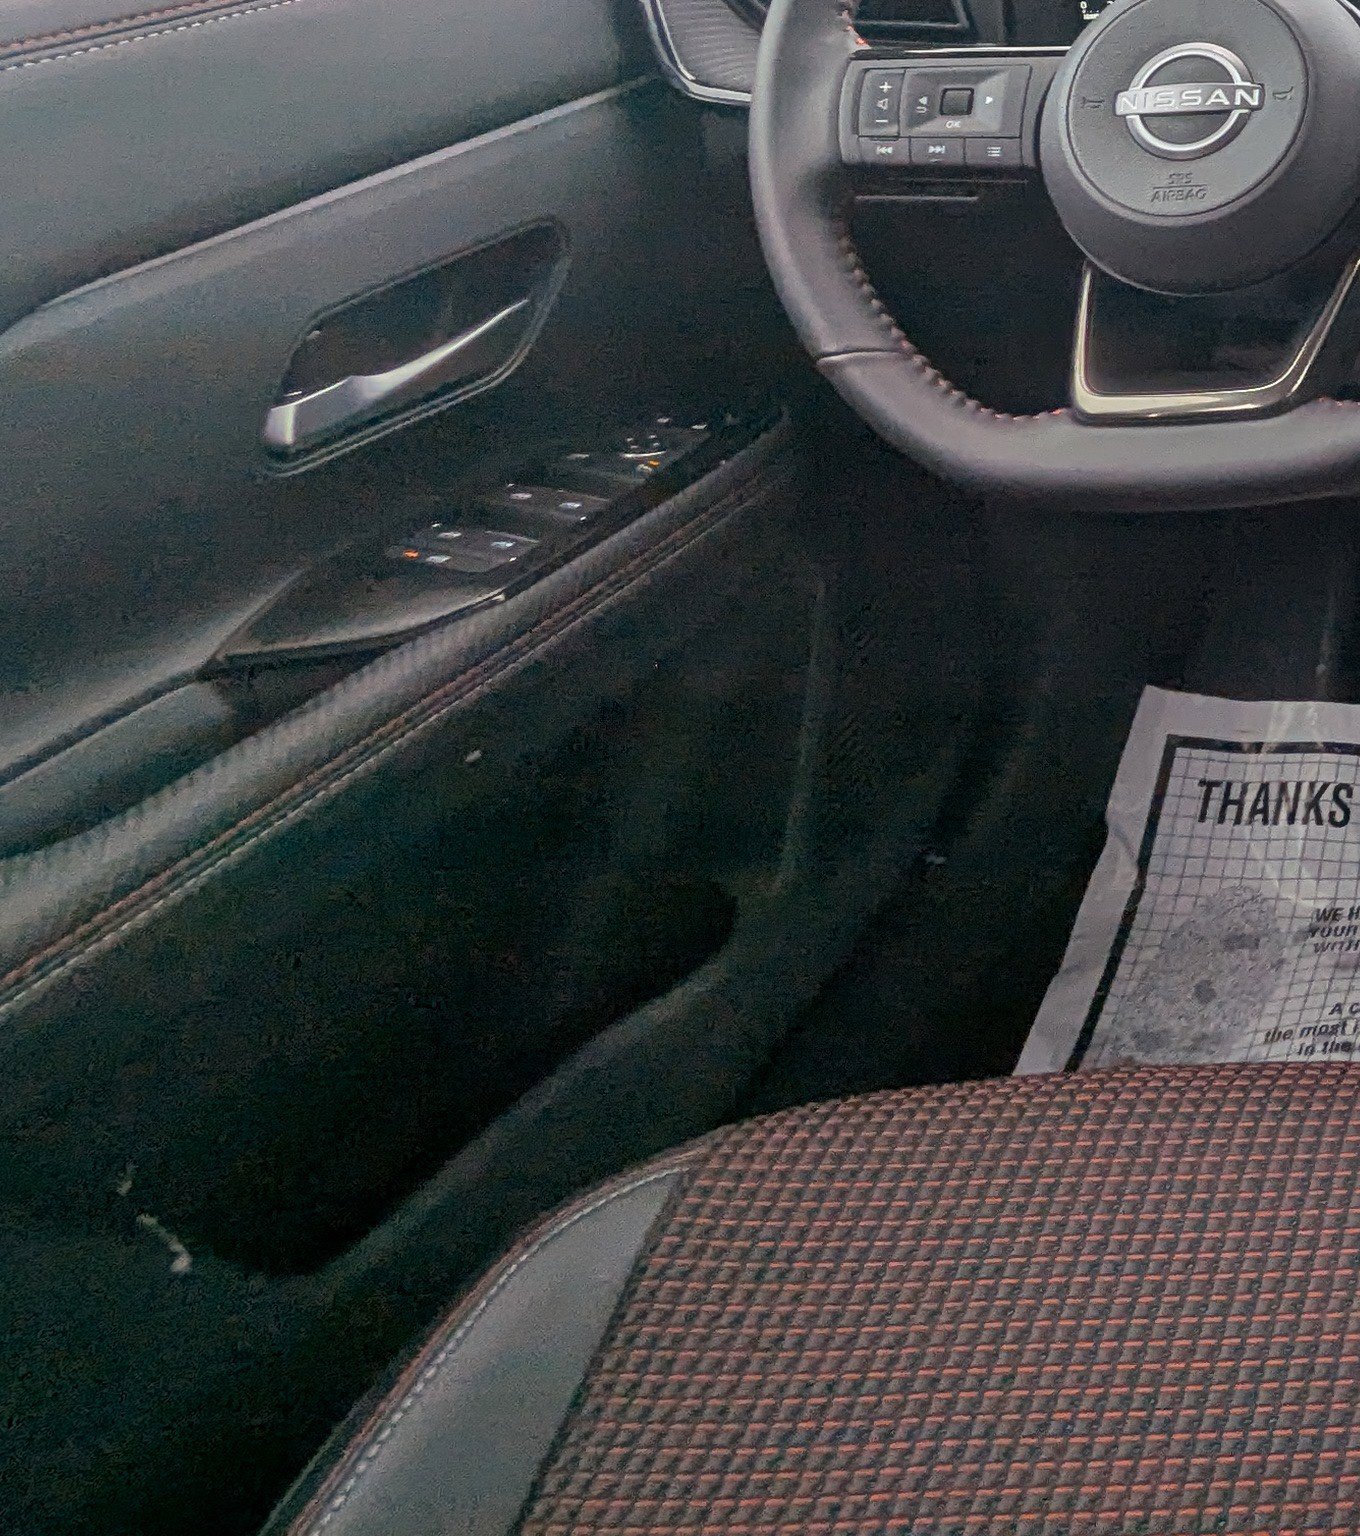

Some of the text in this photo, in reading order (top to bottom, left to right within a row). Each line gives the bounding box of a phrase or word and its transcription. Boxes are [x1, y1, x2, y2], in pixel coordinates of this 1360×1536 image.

[1120, 88, 1260, 112] NISSAN
[946, 120, 961, 129] OK
[1169, 172, 1193, 185] SRS
[1151, 188, 1207, 203] AIRBAG
[1197, 779, 1353, 828] THANKS
[1314, 908, 1344, 923] WE
[1309, 923, 1358, 938] YOUR
[1313, 939, 1360, 954] WITH
[1329, 1003, 1343, 1015] A
[1263, 1028, 1294, 1045] the
[1300, 1019, 1347, 1038] most
[1296, 1044, 1315, 1056] in
[1322, 1038, 1353, 1053] the
